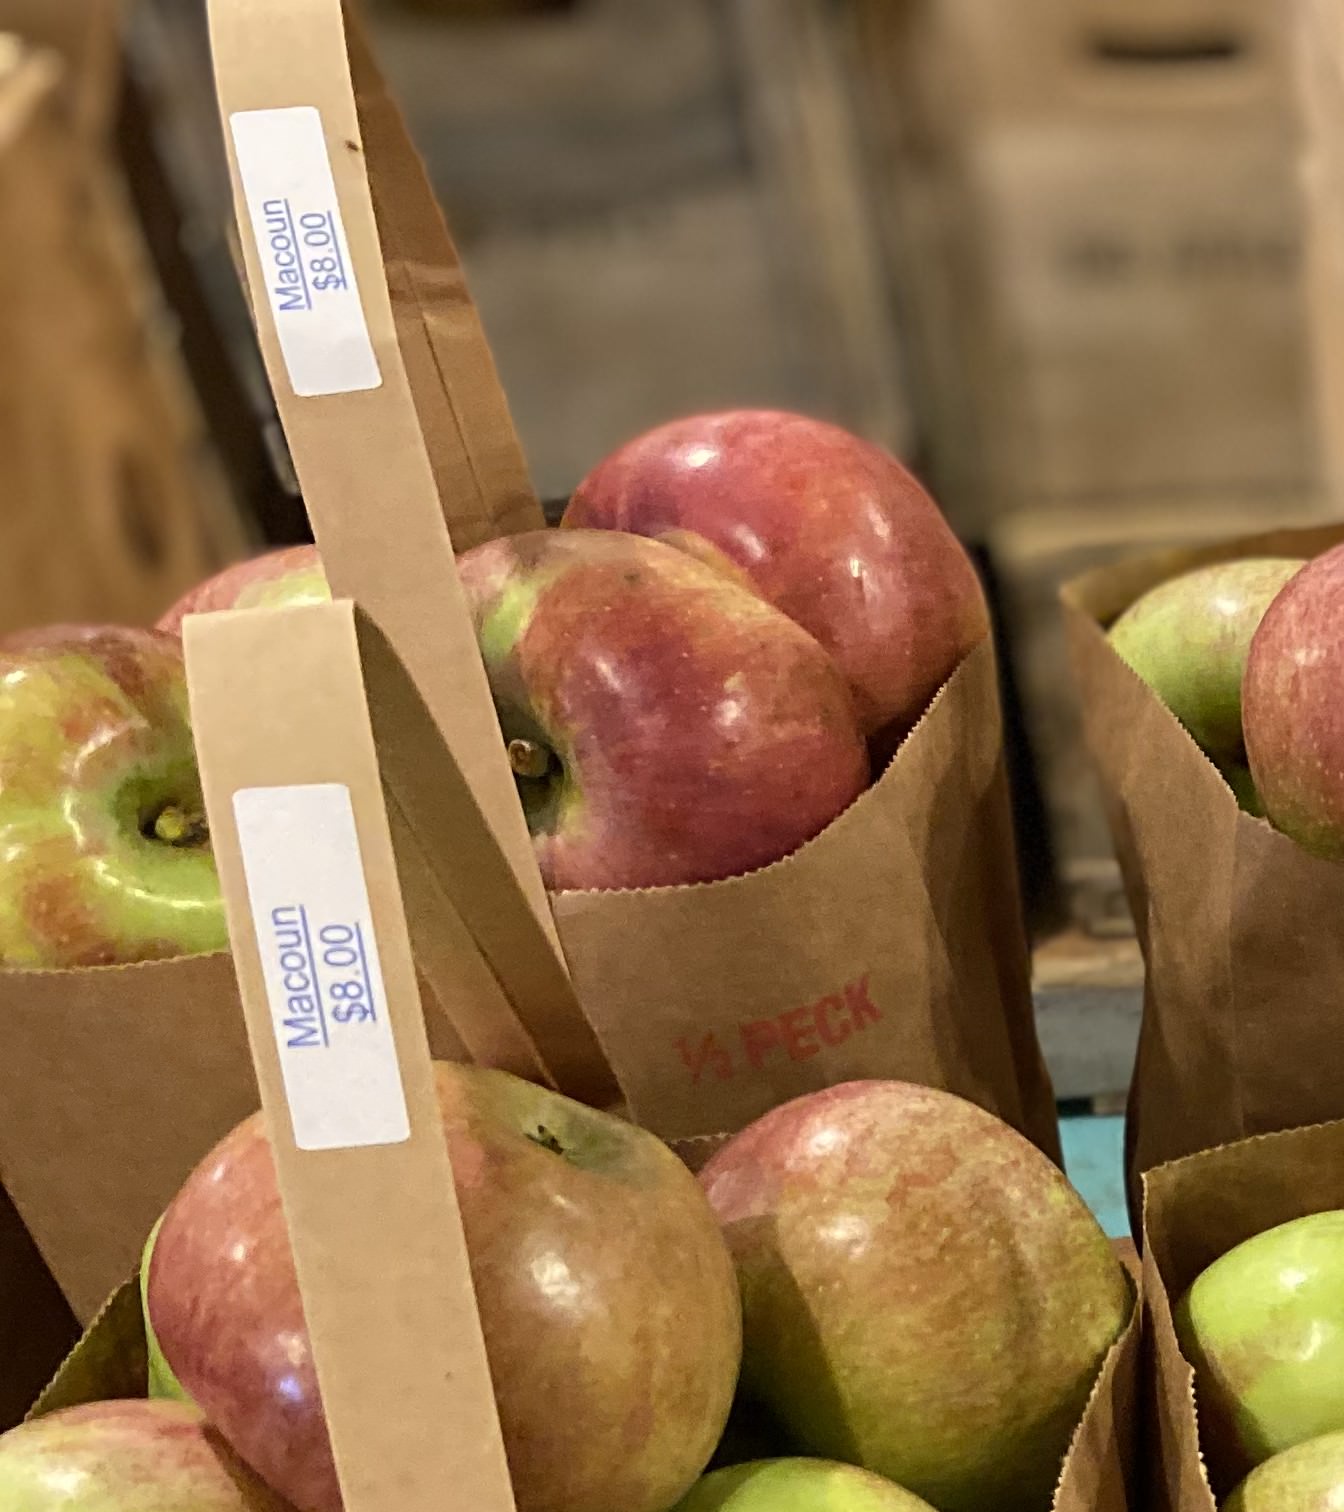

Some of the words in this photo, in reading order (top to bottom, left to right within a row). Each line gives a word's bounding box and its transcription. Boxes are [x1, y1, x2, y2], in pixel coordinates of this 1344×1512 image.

[263, 199, 313, 312] Macoun
[300, 211, 348, 293] $8.00
[272, 905, 329, 1048] Macoun
[320, 923, 377, 1024] $8.00
[739, 975, 883, 1070] PECK
